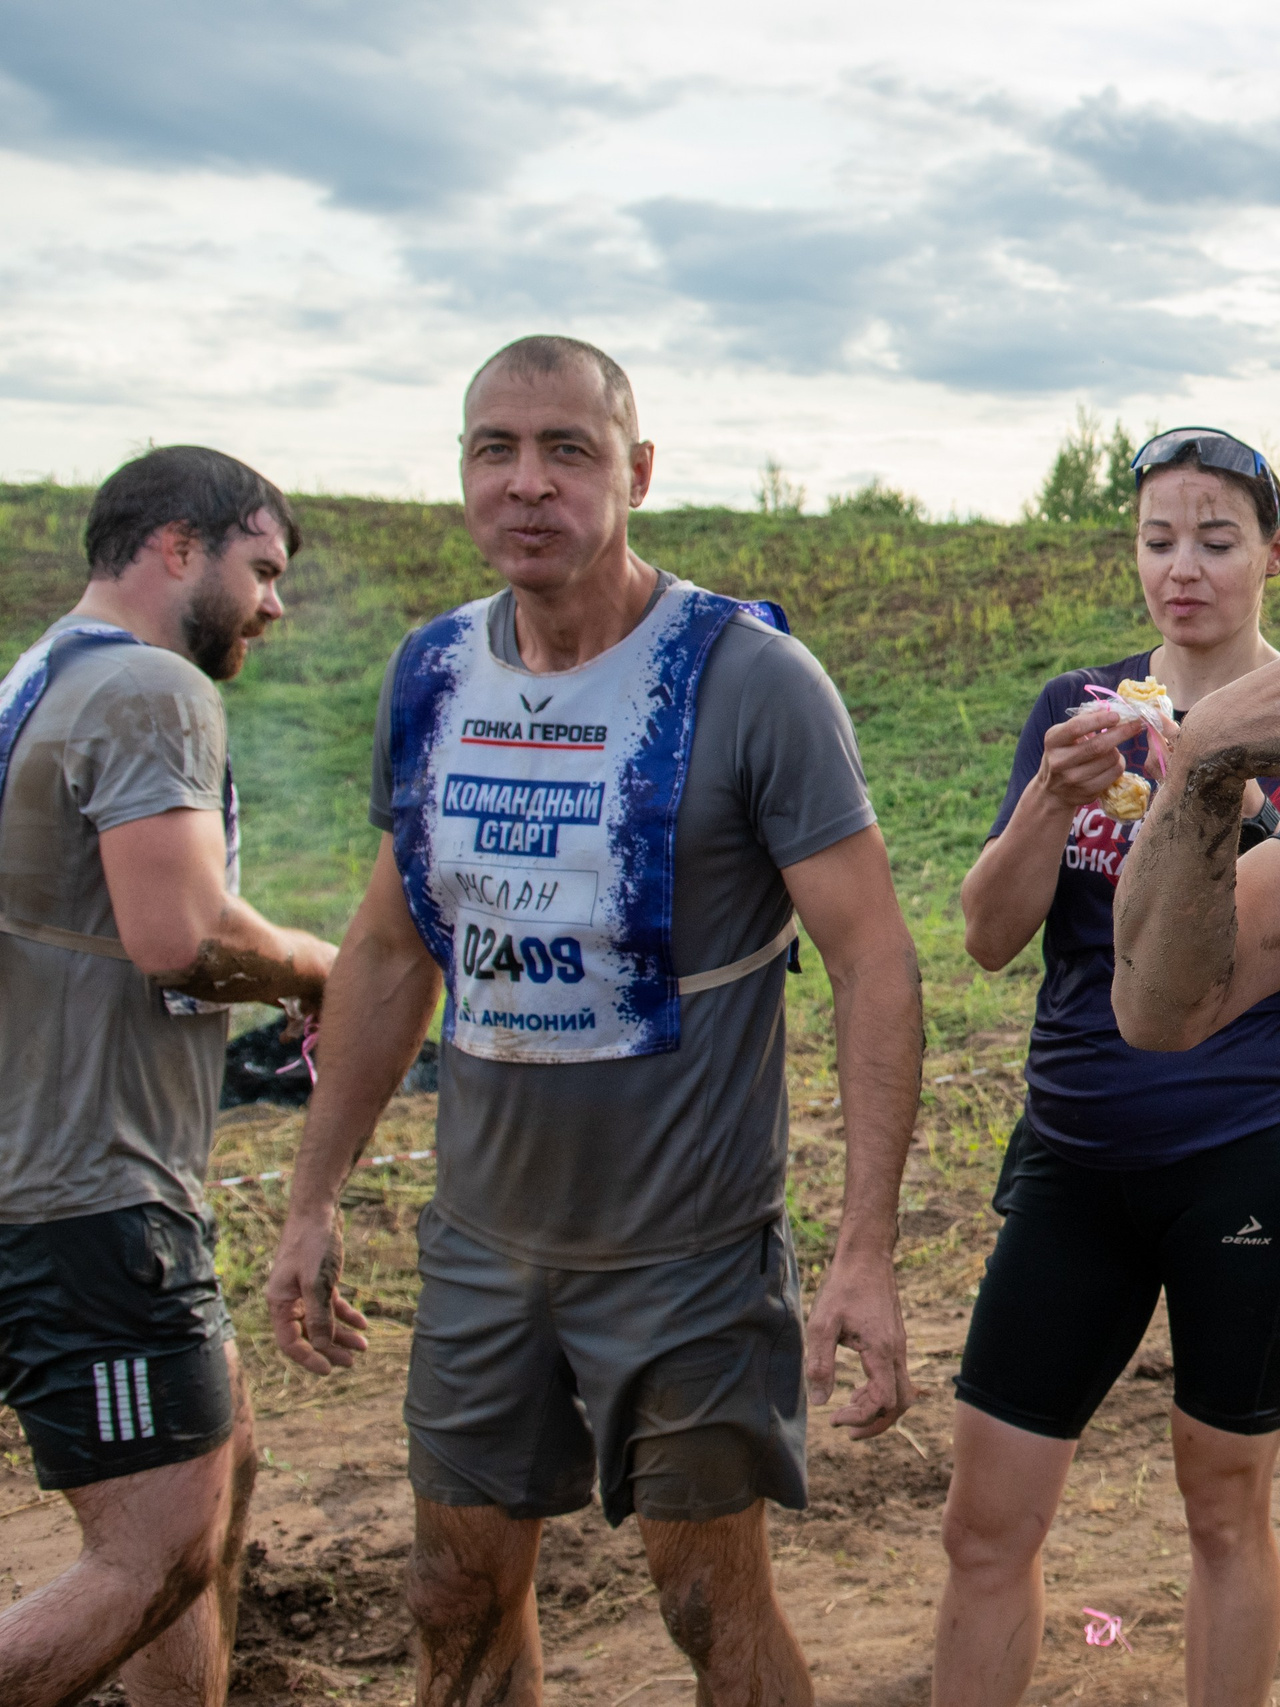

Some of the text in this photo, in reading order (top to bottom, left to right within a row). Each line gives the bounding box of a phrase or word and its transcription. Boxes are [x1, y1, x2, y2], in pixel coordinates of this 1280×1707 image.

[462, 719, 608, 743] ГОНКА ГЕРОЕВ
[445, 780, 601, 819] КОМАНДНЫЙ
[480, 824, 554, 852] СТАРТ
[455, 872, 559, 912] РУСЛАН
[463, 923, 586, 984] 02409
[482, 1007, 596, 1032] АММОНИЙ
[1221, 1236, 1272, 1245] DEMIX
